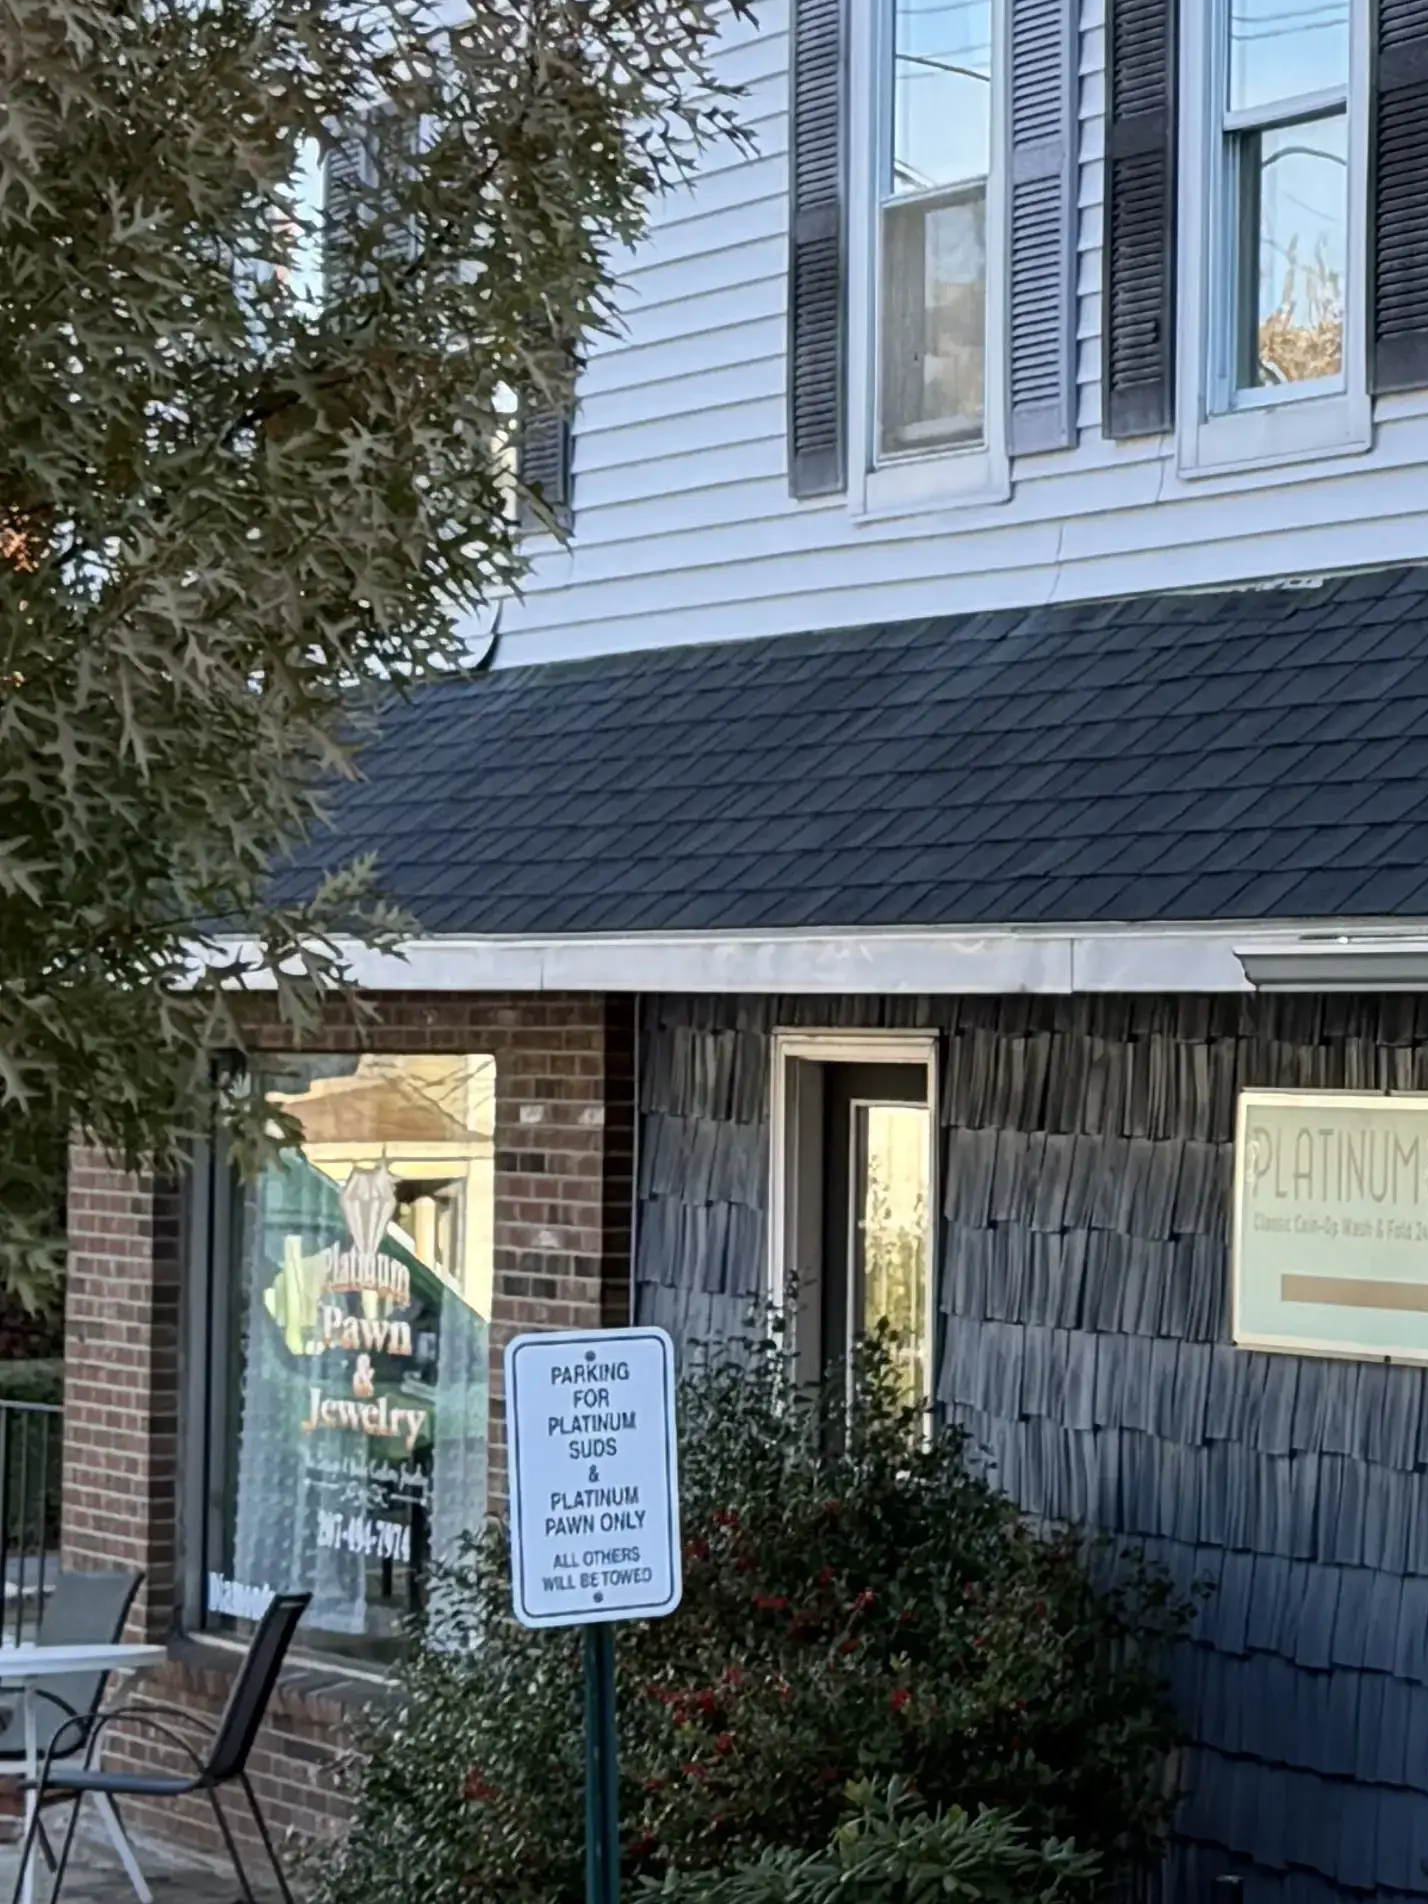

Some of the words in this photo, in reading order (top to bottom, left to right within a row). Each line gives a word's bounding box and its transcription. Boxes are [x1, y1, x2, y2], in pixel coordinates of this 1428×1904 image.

[1251, 1126, 1419, 1204] PLATINUM
[1342, 1218, 1372, 1237] Wash
[1386, 1219, 1411, 1240] Fold
[318, 1300, 412, 1356] Pawn
[353, 1354, 374, 1397] &
[551, 1362, 629, 1384] PARKING
[574, 1389, 609, 1408] FOR
[302, 1387, 427, 1451] Jewelry
[548, 1411, 636, 1435] PLATINUM
[569, 1438, 617, 1459] SUDS
[589, 1465, 599, 1482] &
[551, 1486, 639, 1511] PLATINUM
[545, 1514, 594, 1537] PAWN
[600, 1511, 646, 1532] ONLY
[553, 1550, 579, 1569] ALL
[583, 1547, 640, 1566] OTHERS
[542, 1573, 576, 1592] WILL
[581, 1571, 600, 1589] BE
[601, 1567, 652, 1587] TOWED
